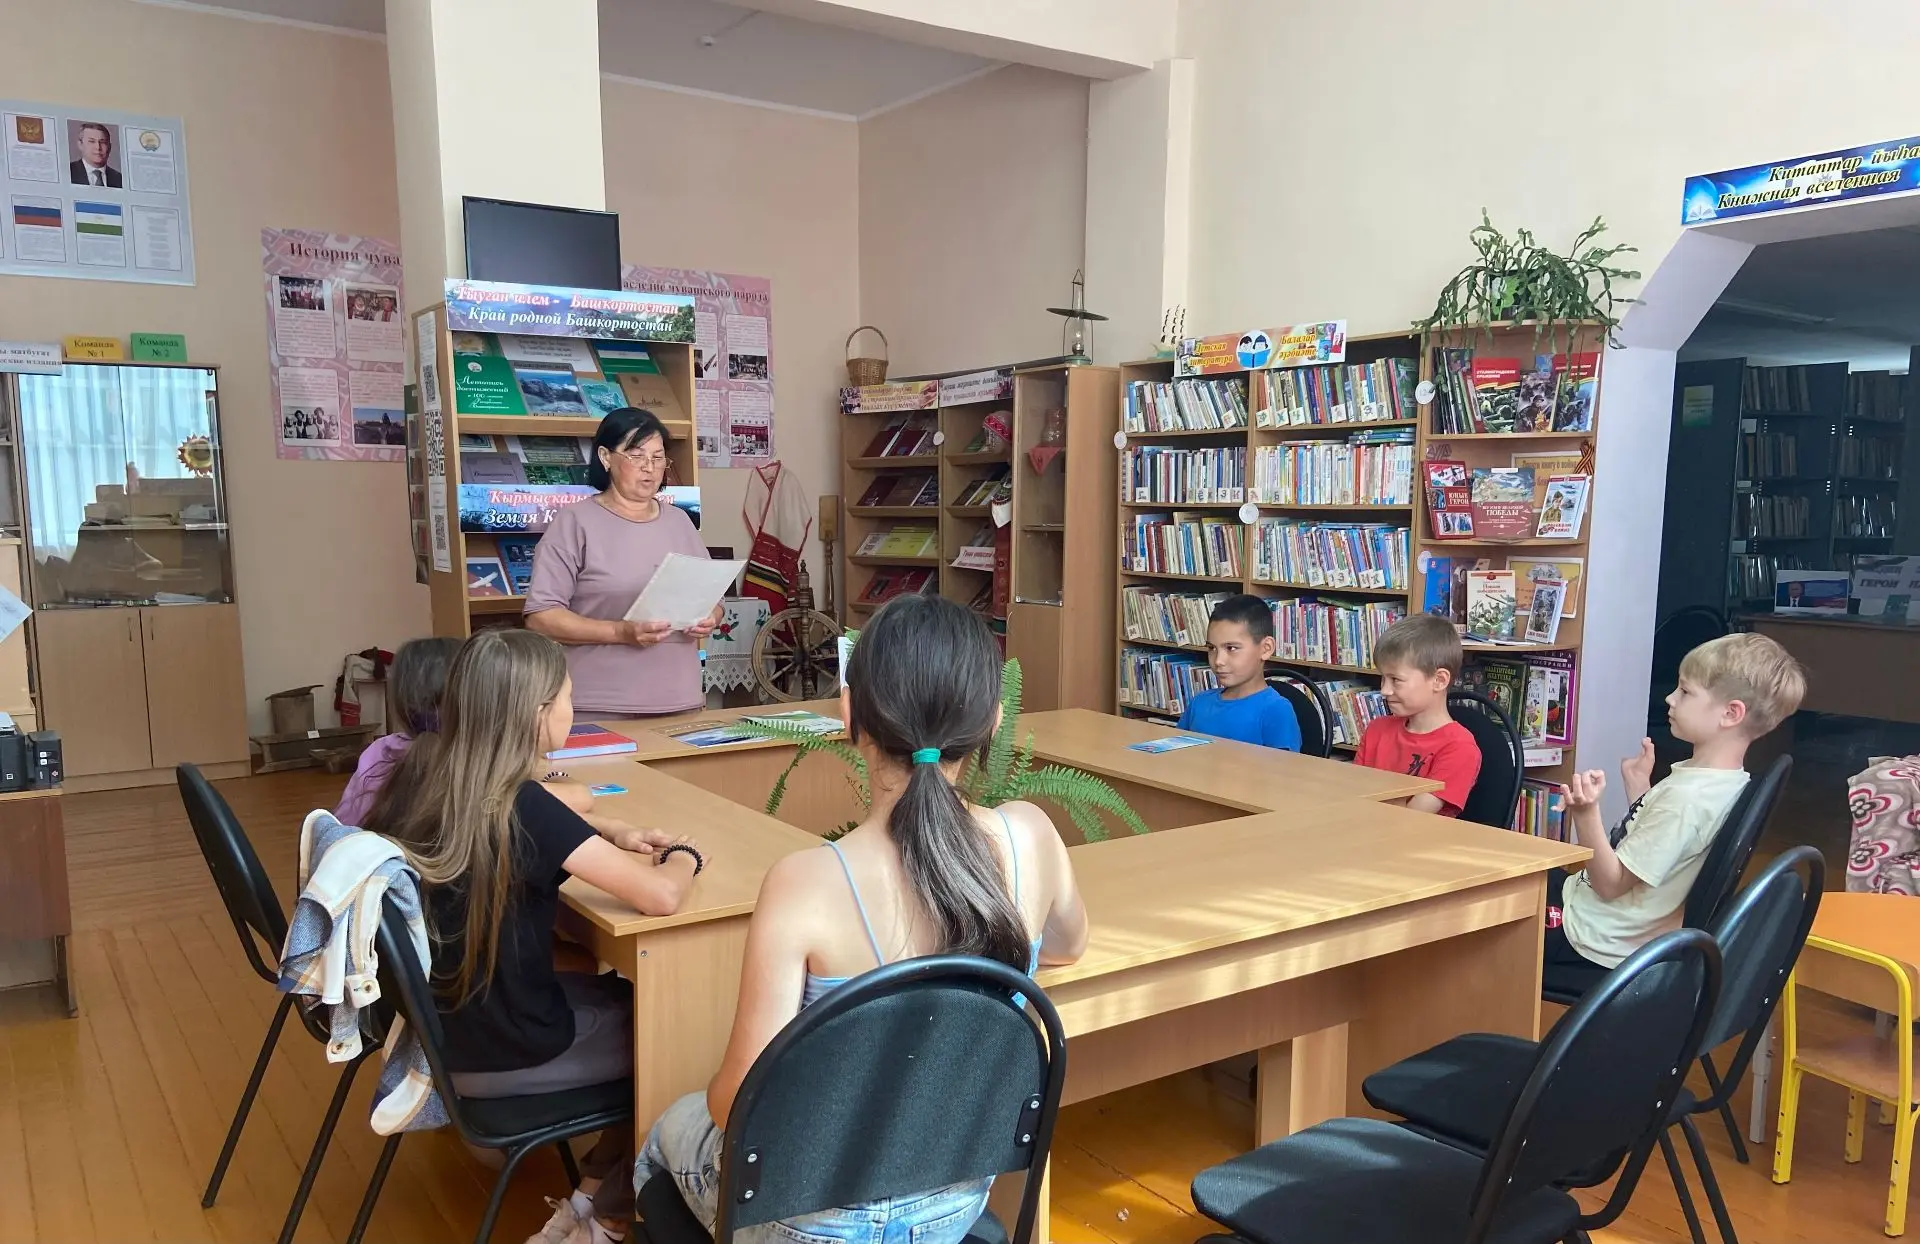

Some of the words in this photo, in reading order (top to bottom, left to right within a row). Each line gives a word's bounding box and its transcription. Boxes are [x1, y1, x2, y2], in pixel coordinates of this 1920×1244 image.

[1769, 156, 1862, 183] Китаптар
[1718, 187, 1800, 209] Книжная
[1806, 170, 1900, 195] вселенная
[290, 242, 359, 264] История
[623, 280, 665, 291] аследие
[668, 284, 731, 297] чувашского
[734, 292, 768, 302] народа
[469, 306, 506, 325] Край
[510, 311, 561, 326] родной
[566, 313, 673, 332] Башкортостан
[74, 340, 114, 348] Команда
[139, 337, 179, 347] Команда
[487, 508, 538, 523] Земля
